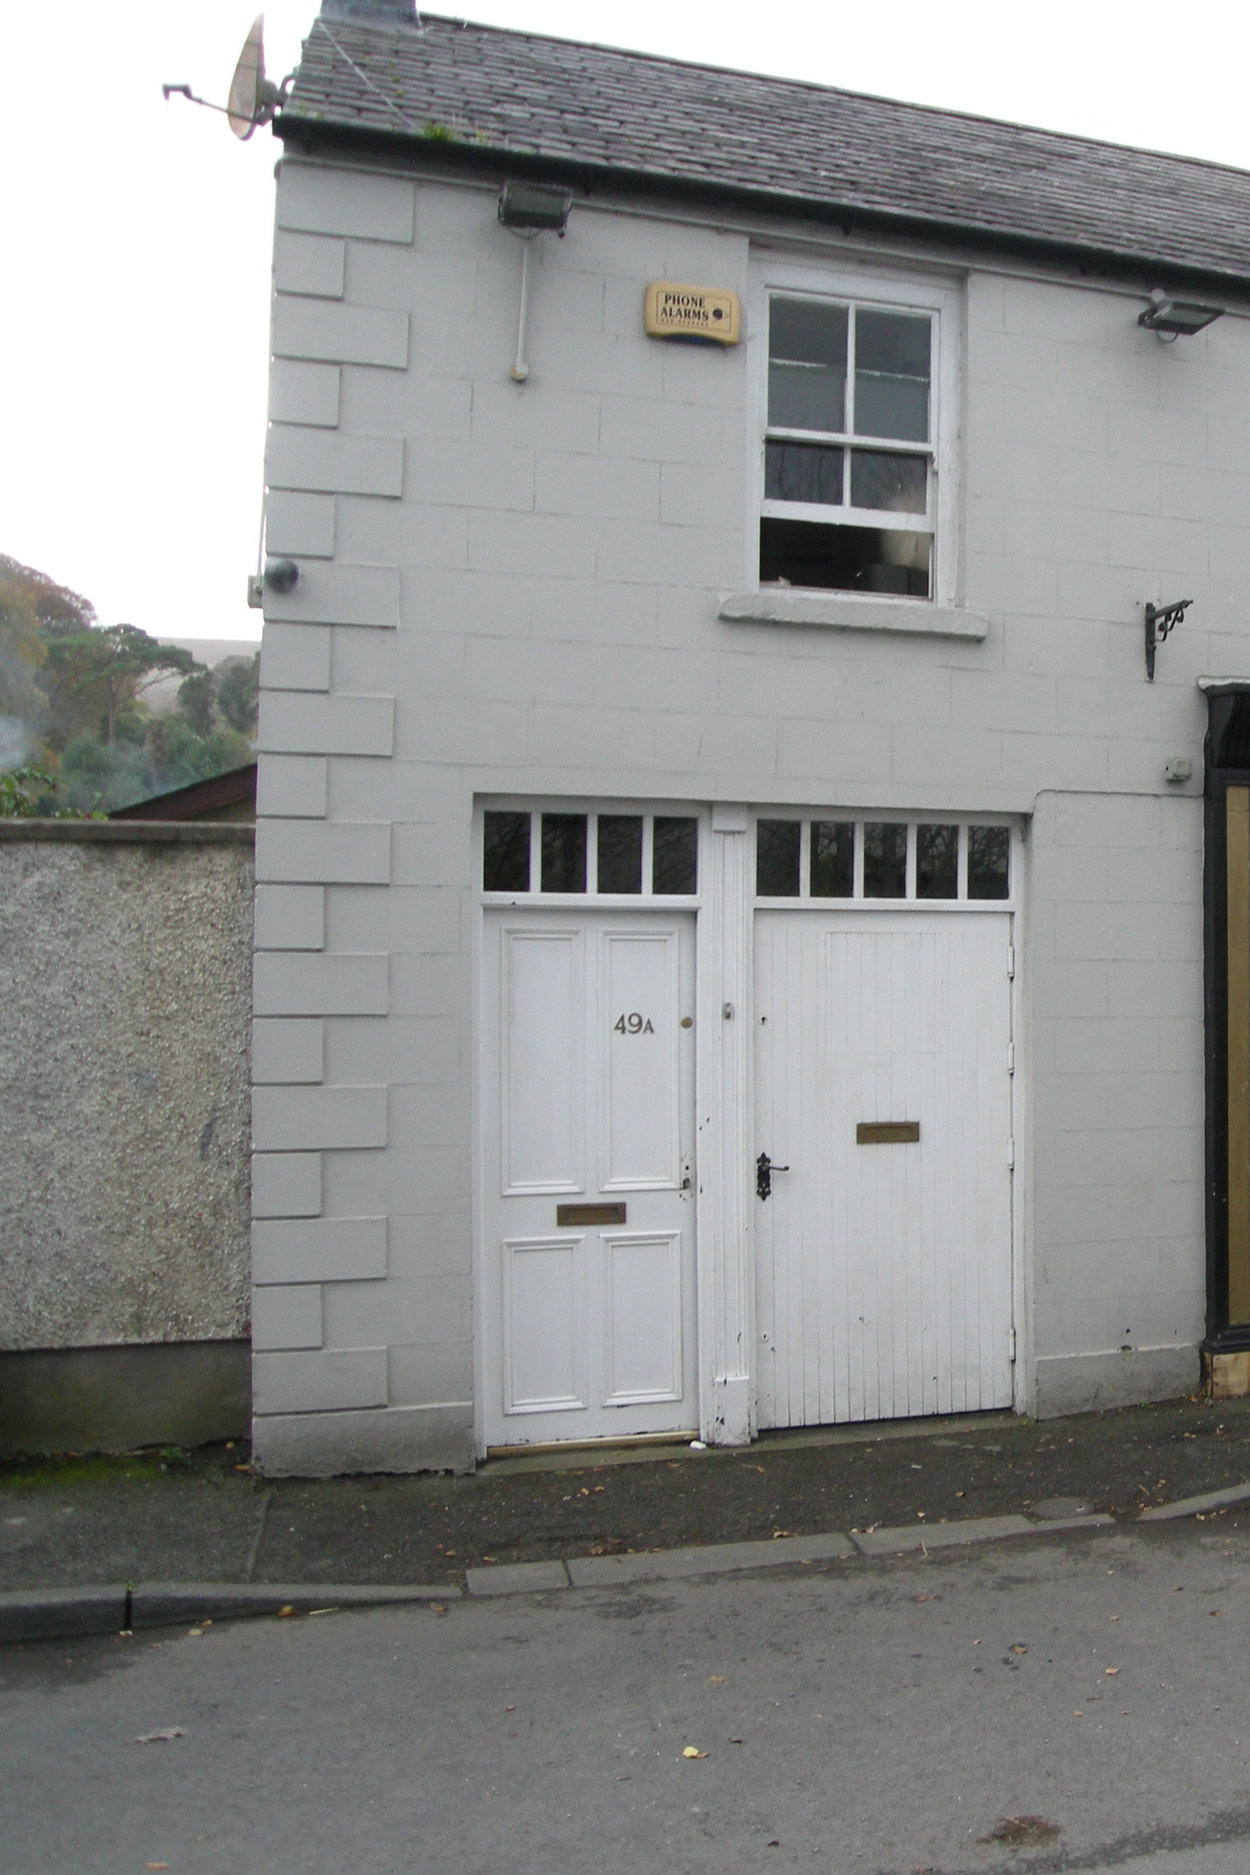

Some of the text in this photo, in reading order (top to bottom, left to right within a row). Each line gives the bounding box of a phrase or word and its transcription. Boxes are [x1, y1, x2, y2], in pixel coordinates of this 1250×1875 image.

[664, 293, 706, 309] PHONE
[660, 306, 709, 321] ALARMS
[614, 1012, 655, 1035] 49A
